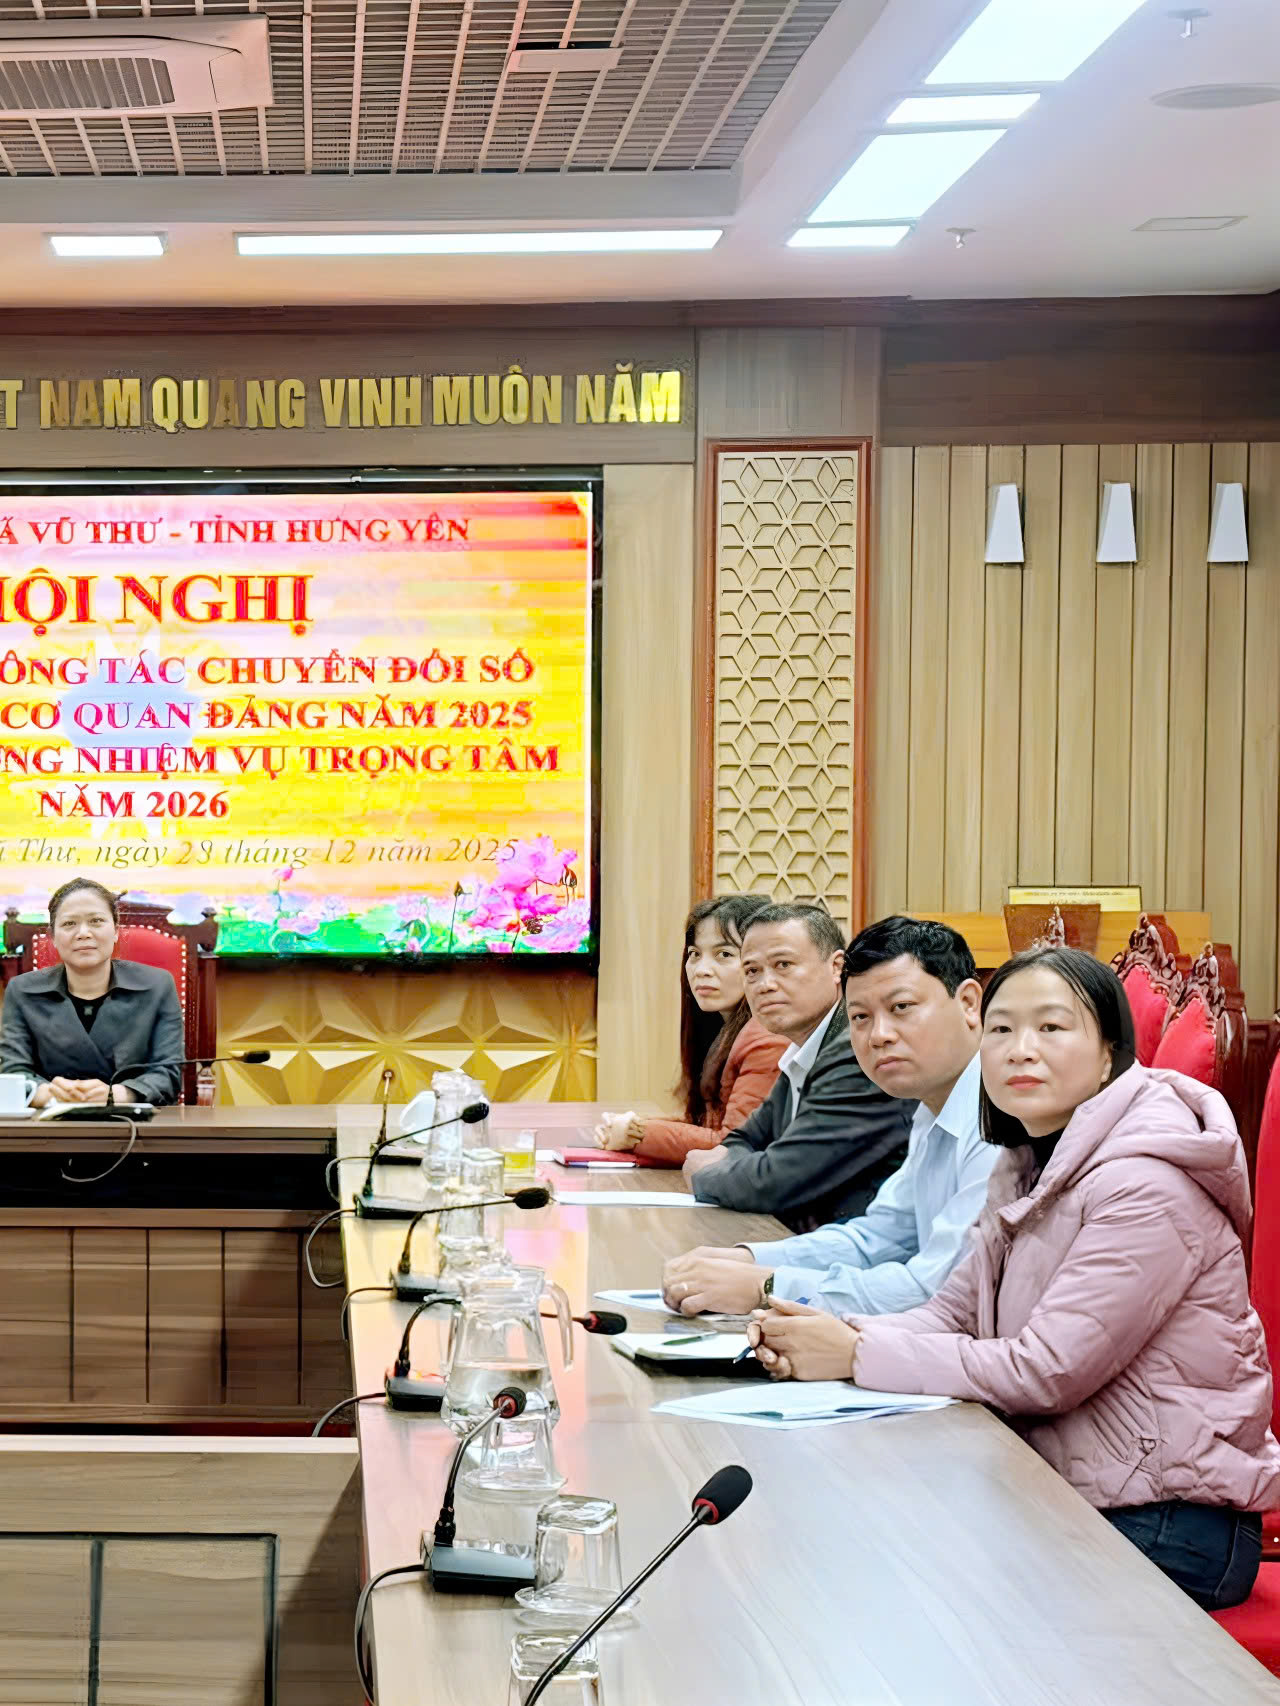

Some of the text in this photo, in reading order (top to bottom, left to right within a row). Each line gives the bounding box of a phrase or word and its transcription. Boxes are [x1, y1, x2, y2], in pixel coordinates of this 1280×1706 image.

[40, 378, 141, 428] NAM
[152, 375, 306, 433] QUANG
[320, 377, 421, 428] VINH
[433, 364, 561, 426] MUÔN
[576, 362, 681, 424] NĂM
[27, 516, 76, 545] VŨ
[85, 517, 163, 544] THƯ
[190, 514, 278, 544] TỈNH
[285, 515, 390, 543] HƯNG
[398, 512, 470, 543] YÊN
[114, 574, 314, 636] NGHỊ
[99, 648, 186, 684] TÁC
[0, 700, 63, 730] CƠ
[73, 702, 195, 735] QUAN
[202, 694, 328, 729] ĐẢNG
[336, 693, 439, 729] NĂM
[448, 700, 535, 729] 2025
[73, 742, 220, 780] NHIỆM
[227, 745, 288, 780] VỤ
[299, 744, 455, 779] TRỌNG
[462, 737, 561, 773] TÂM
[36, 783, 230, 818] NĂM 2026
[95, 838, 167, 869] ngày
[224, 838, 309, 869] tháng
[324, 839, 357, 863] 12
[367, 839, 432, 862] năm
[443, 838, 519, 862] 2025
